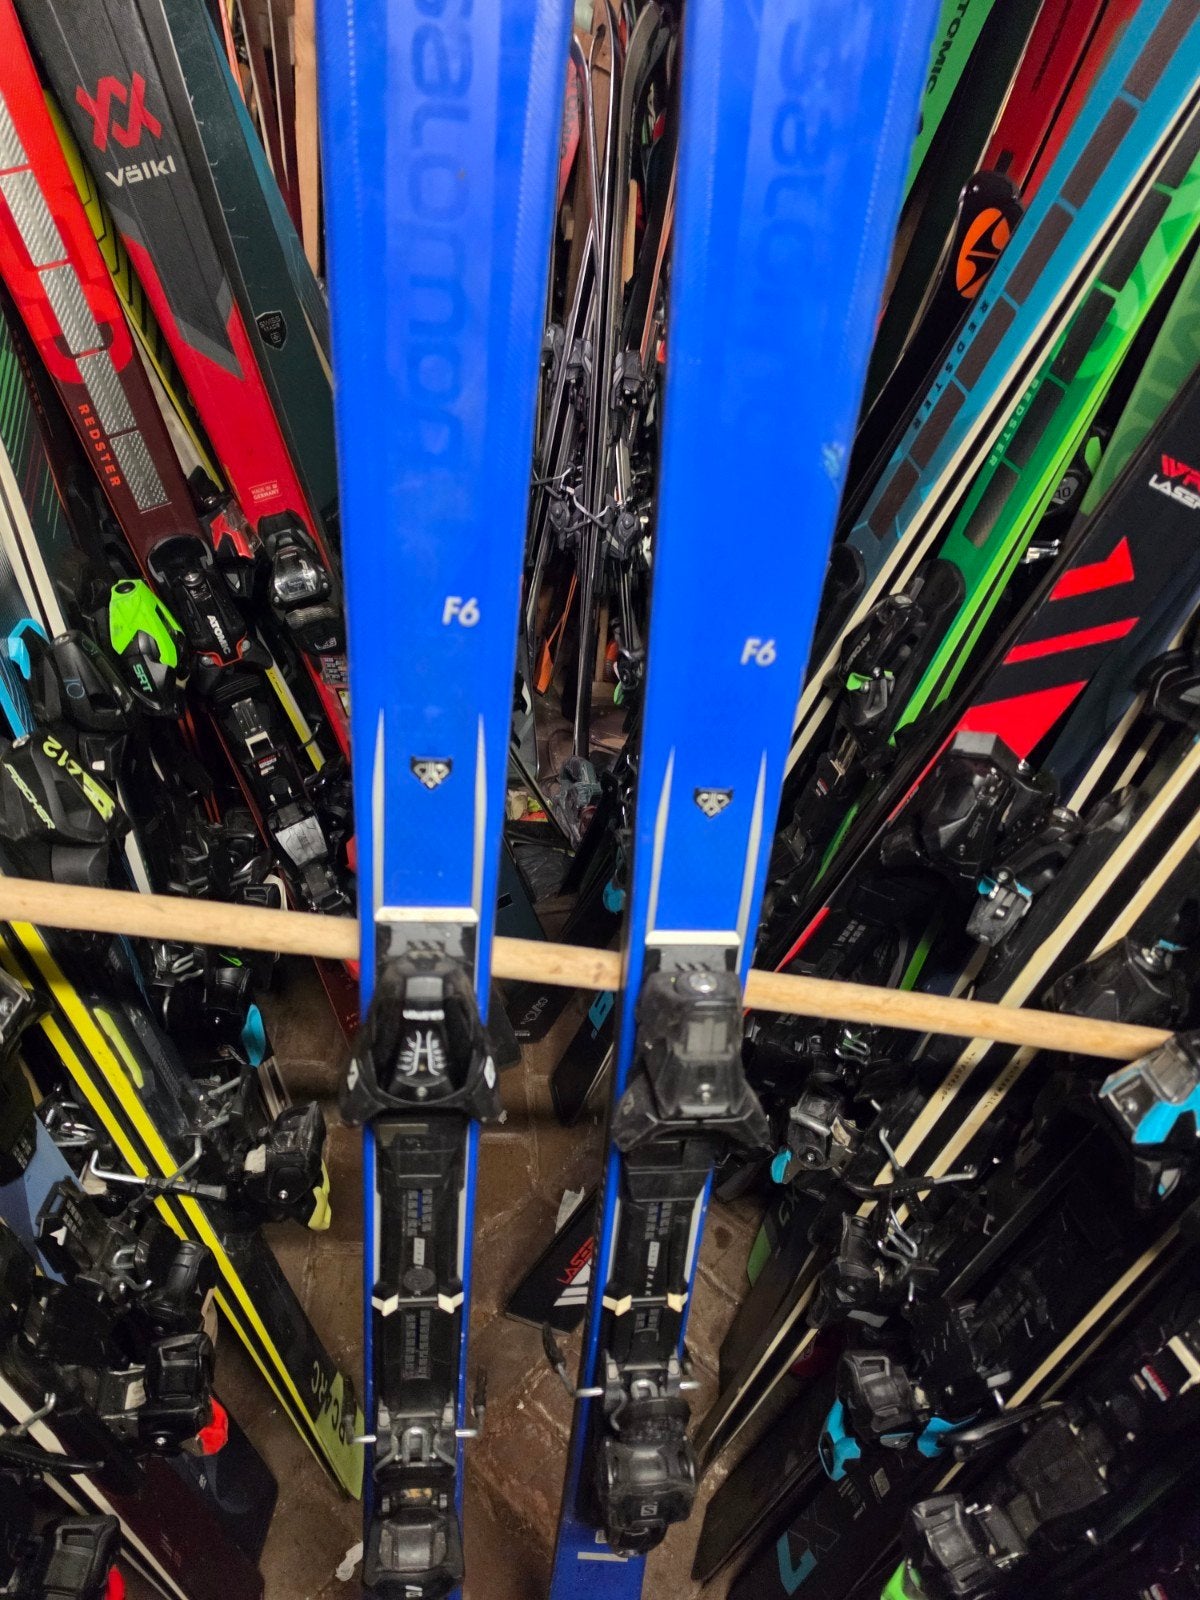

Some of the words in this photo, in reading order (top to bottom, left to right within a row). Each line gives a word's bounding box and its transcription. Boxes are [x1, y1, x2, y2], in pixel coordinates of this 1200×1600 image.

[928, 0, 971, 95] TOMIC
[105, 155, 177, 187] Völkl
[911, 301, 990, 431] REDSTER
[989, 378, 1040, 468] REDSTER
[77, 403, 121, 488] REDSTER
[442, 597, 480, 627] F6
[206, 616, 231, 655] ATOMIC
[740, 638, 776, 667] F6
[845, 633, 871, 673] ATOMIC
[133, 664, 153, 693] SRT
[4, 763, 56, 829] FISCHER
